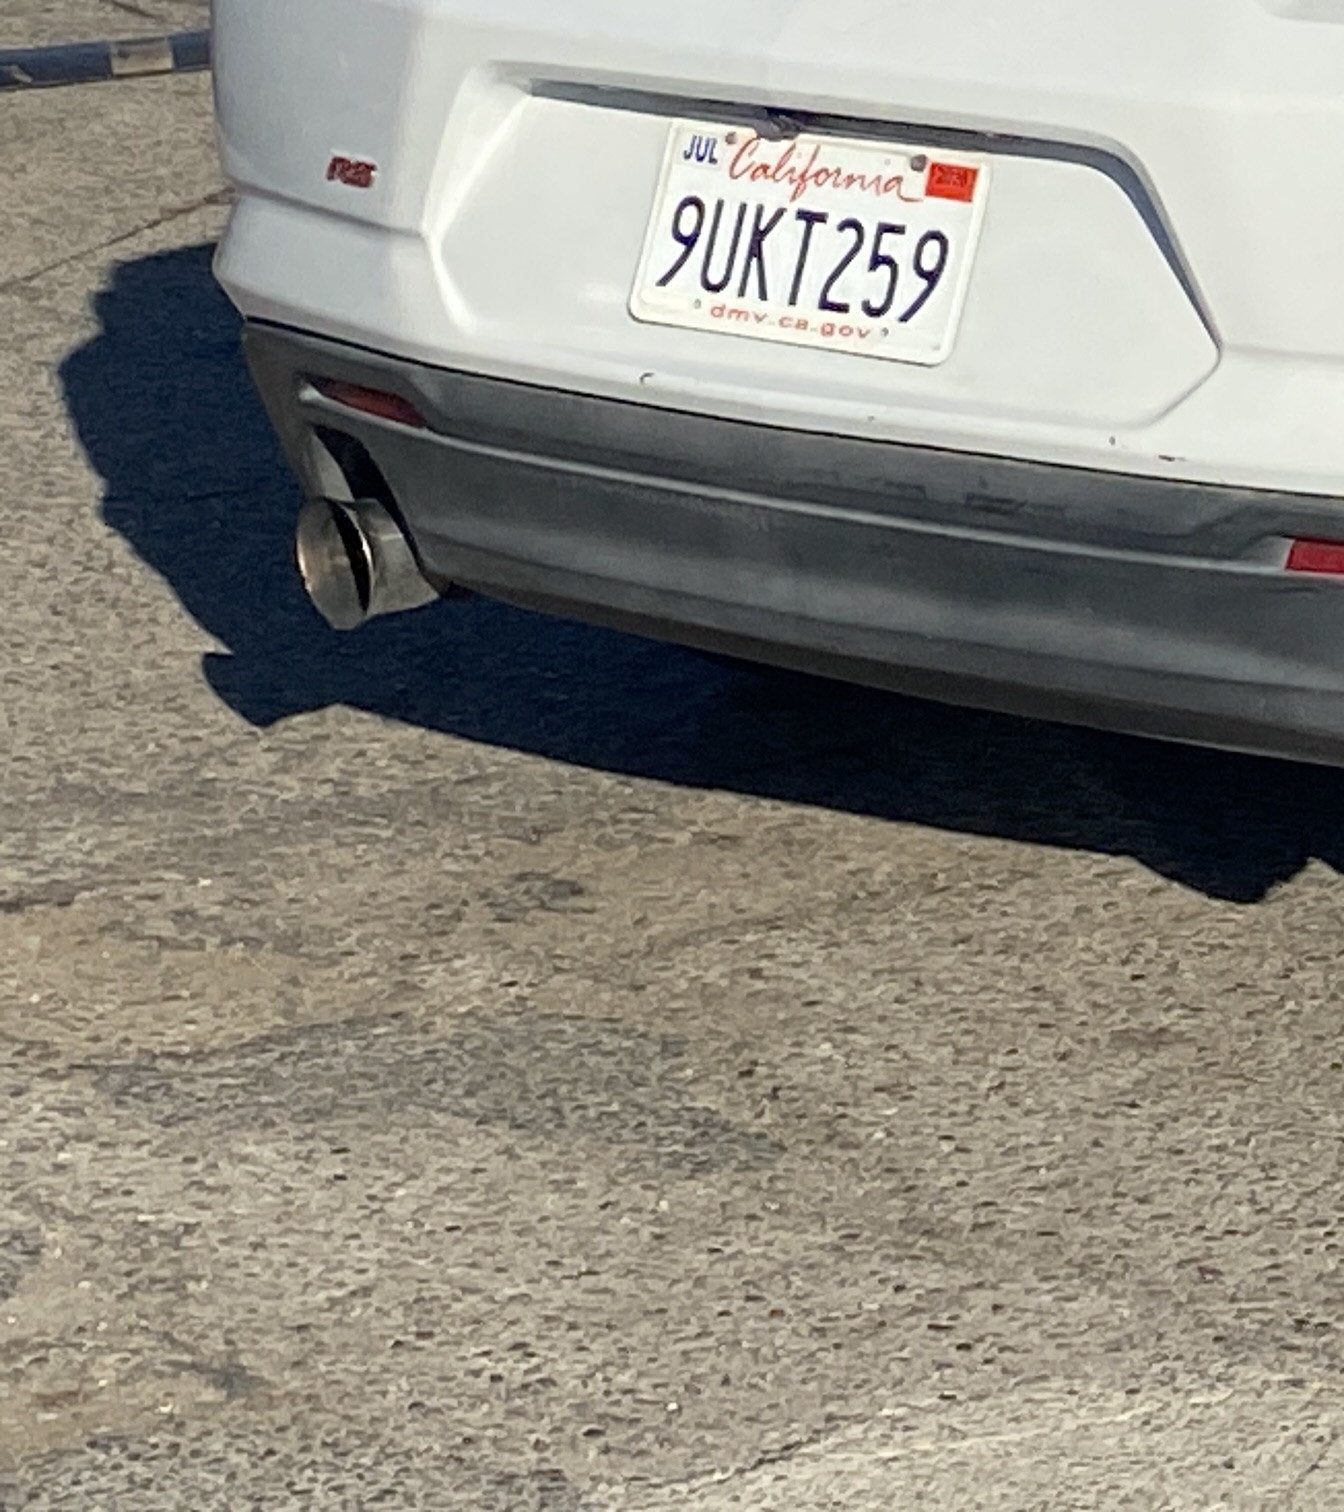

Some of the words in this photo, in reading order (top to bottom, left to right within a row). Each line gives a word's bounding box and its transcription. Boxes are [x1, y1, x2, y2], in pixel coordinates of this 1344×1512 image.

[683, 134, 718, 164] JUL
[727, 136, 926, 202] California
[655, 195, 949, 322] 9UKT259
[710, 304, 871, 339] dmv.ca.gov
